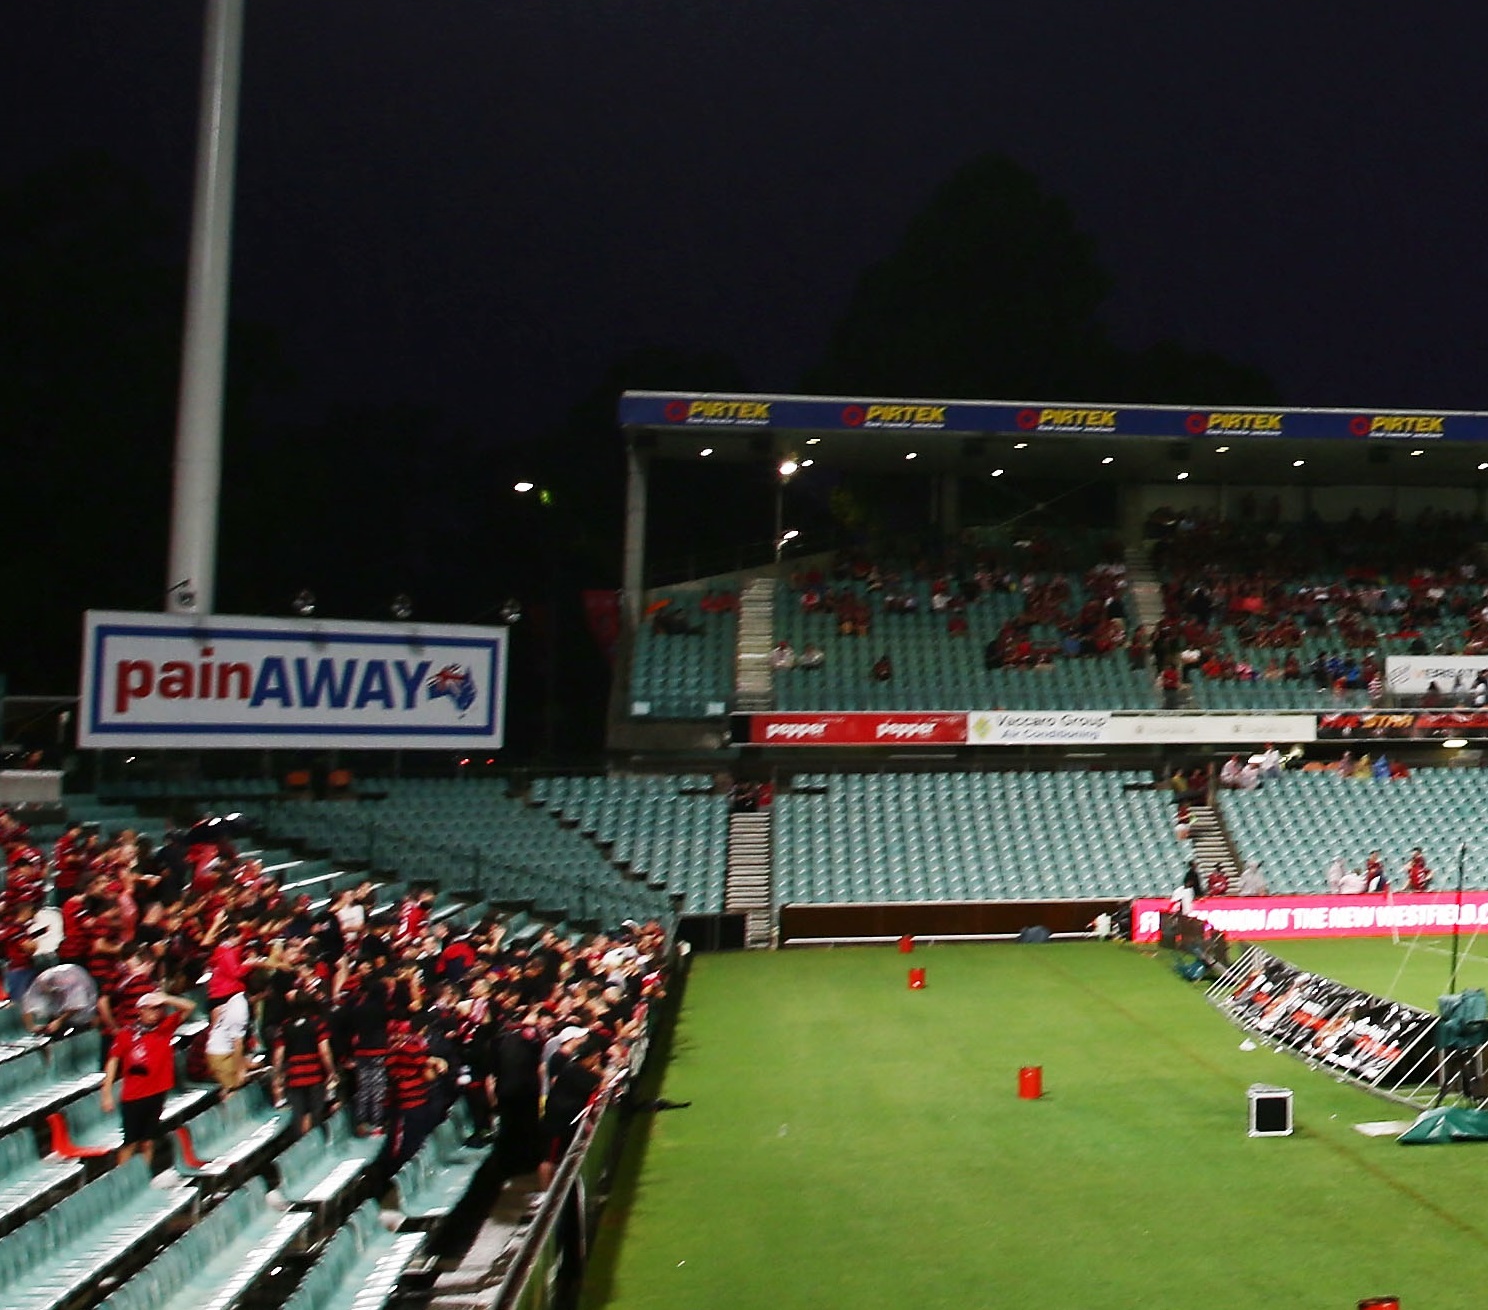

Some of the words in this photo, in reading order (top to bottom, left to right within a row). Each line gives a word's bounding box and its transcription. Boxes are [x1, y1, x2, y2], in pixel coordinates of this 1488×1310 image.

[687, 401, 770, 419] PIRTEK
[865, 404, 946, 423] PIRTEK
[1039, 408, 1117, 426] PIRTEK
[1207, 413, 1283, 430] PIRTEK
[1369, 416, 1444, 433] PIRTEK
[112, 646, 433, 714] painAWAY
[998, 716, 1057, 729] Vaccaro
[1059, 714, 1108, 729] Group
[1290, 908, 1329, 929] THE
